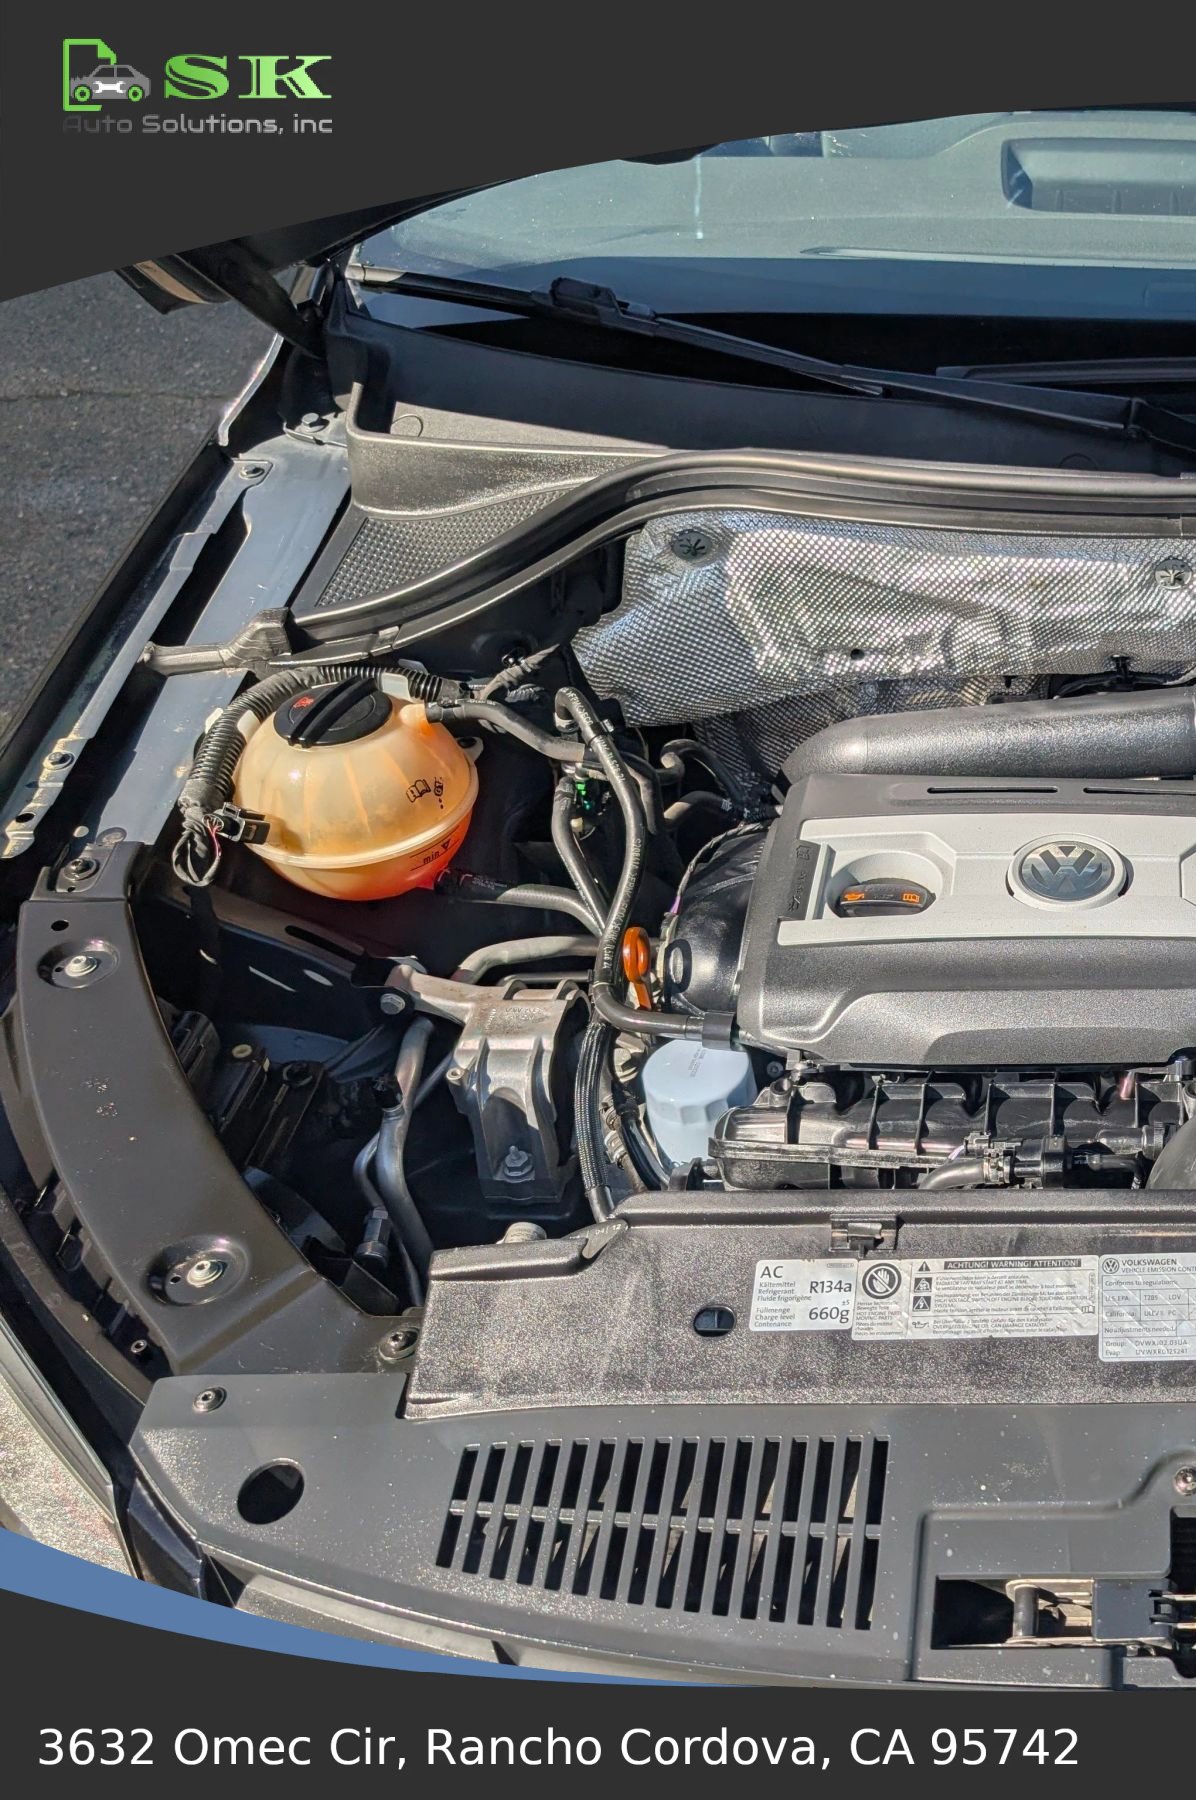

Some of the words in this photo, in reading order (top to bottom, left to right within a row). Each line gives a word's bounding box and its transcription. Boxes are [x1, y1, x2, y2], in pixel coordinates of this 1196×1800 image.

[760, 1266, 783, 1278] AC
[810, 1280, 852, 1294] R134a
[809, 1307, 850, 1323] 660g
